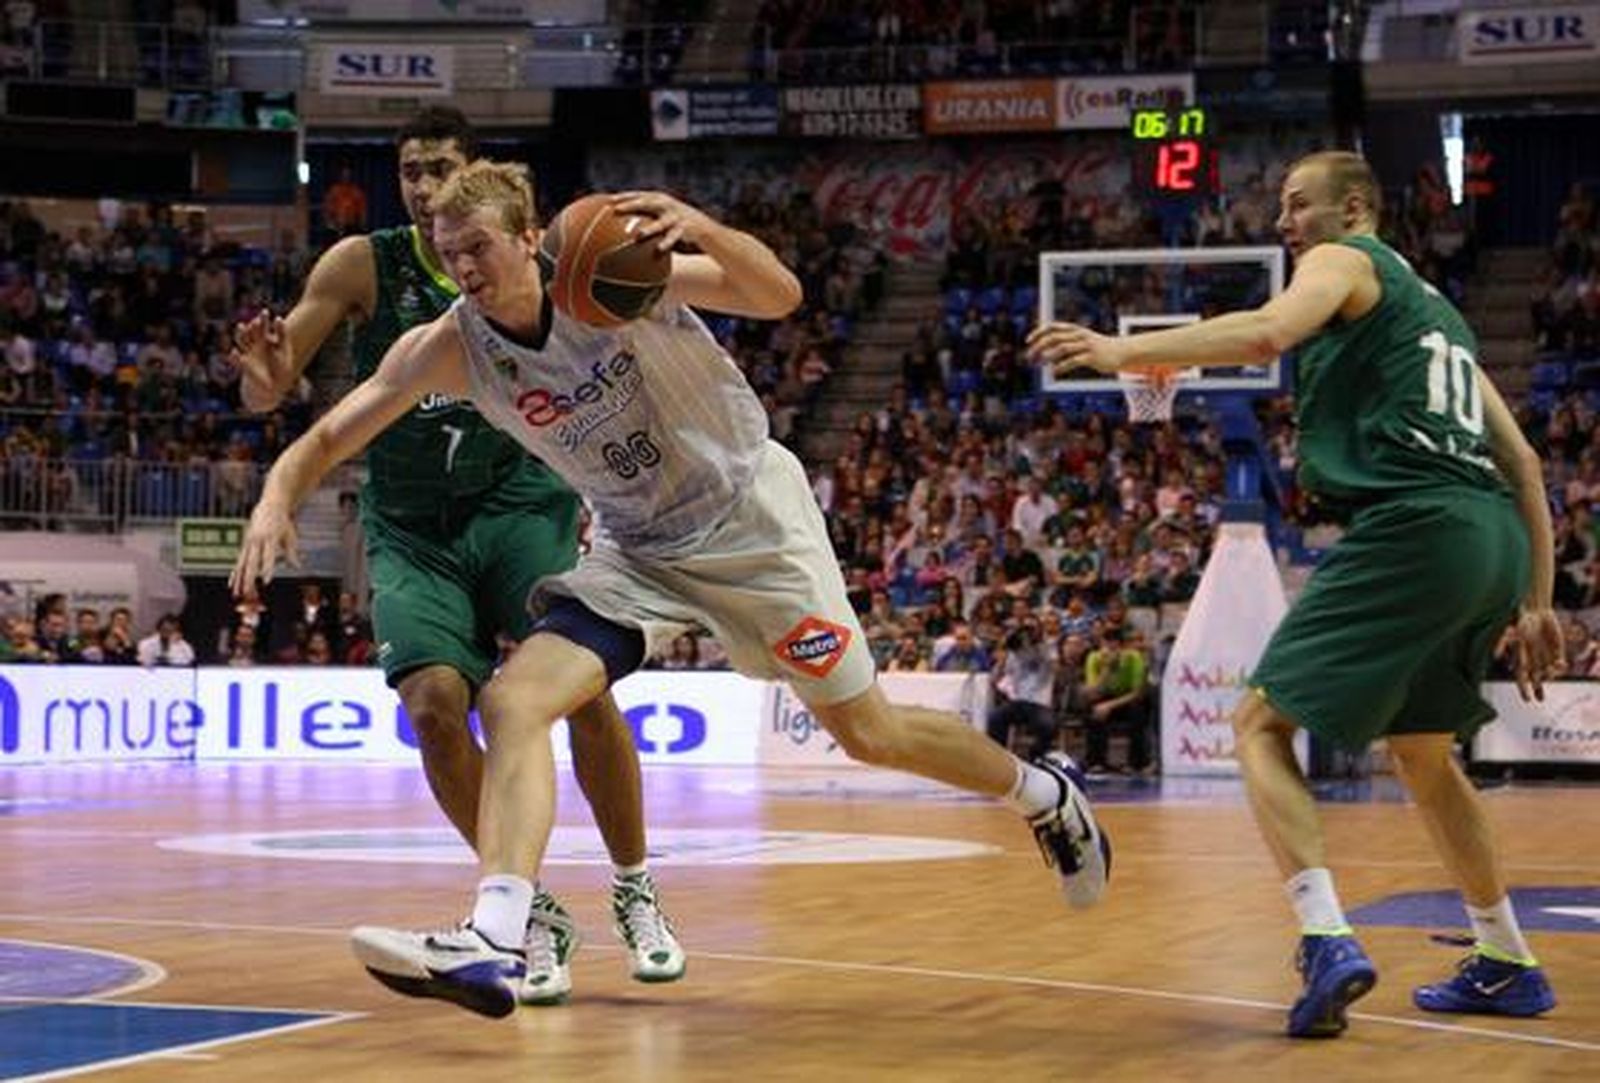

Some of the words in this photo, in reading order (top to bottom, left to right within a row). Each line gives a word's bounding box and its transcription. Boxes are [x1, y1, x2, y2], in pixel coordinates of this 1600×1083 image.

[1475, 15, 1585, 44] SUR
[338, 54, 435, 77] SUR
[933, 98, 1048, 122] URANIA
[1157, 141, 1199, 190] 12
[1419, 331, 1484, 435] 10
[441, 424, 464, 474] 7
[771, 686, 822, 745] lig
